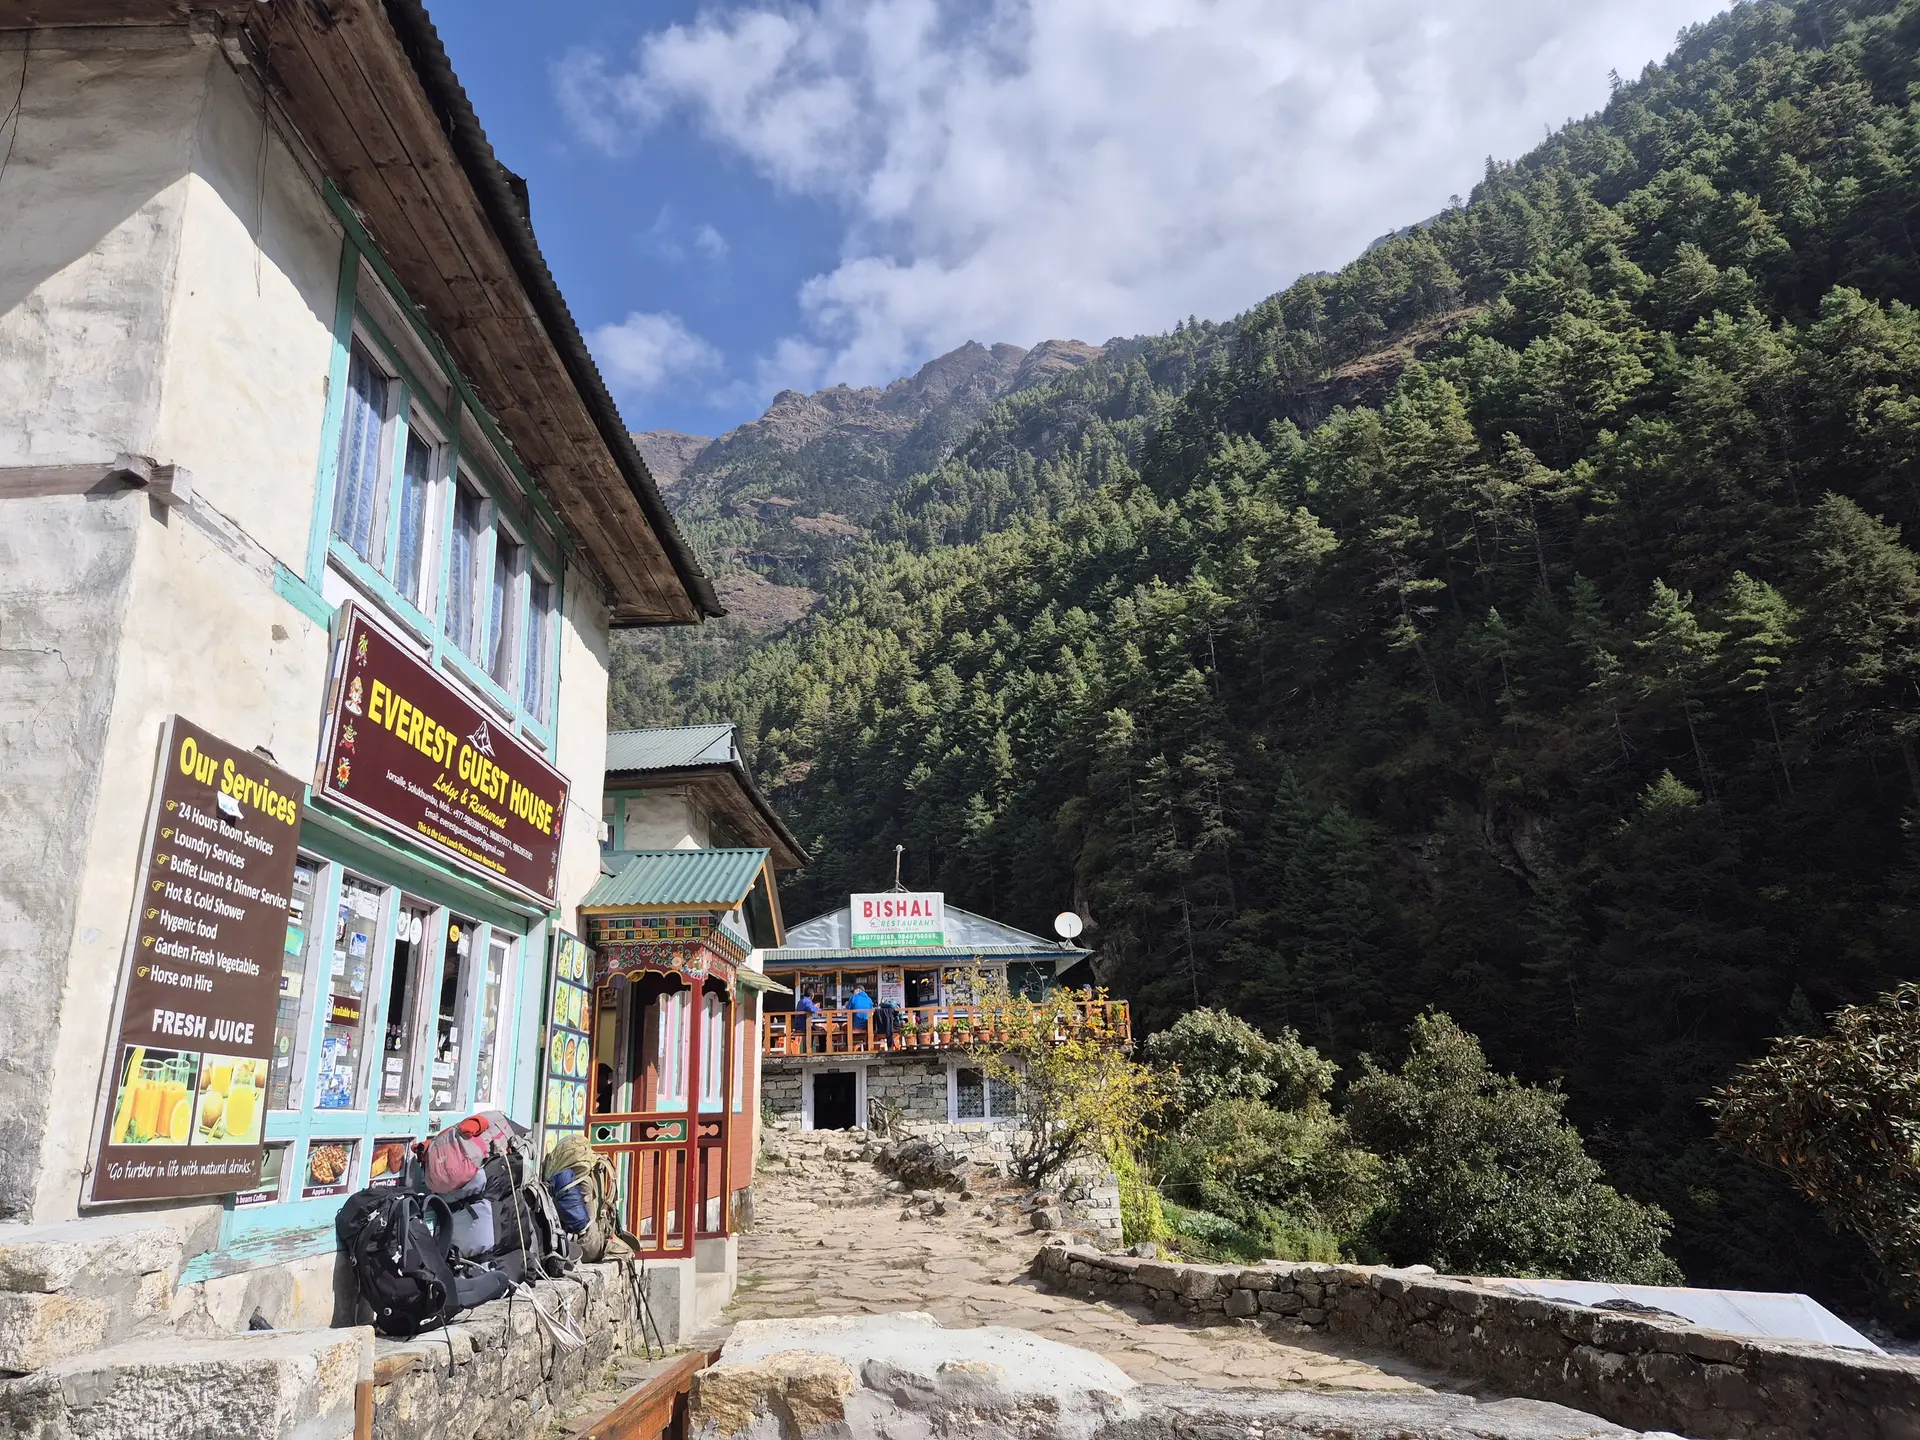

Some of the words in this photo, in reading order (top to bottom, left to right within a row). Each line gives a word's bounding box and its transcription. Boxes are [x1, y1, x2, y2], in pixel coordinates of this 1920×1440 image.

[368, 678, 457, 770] EVEREST
[458, 744, 510, 804] GUEST
[510, 782, 553, 836] HOUSE
[180, 736, 219, 786] Our
[220, 758, 297, 826] Services
[386, 769, 407, 790] Jorsalle,
[407, 782, 438, 808] Solukhumbu,
[425, 807, 440, 823] Email:
[432, 773, 460, 803] Lodge
[460, 788, 468, 804] &
[468, 793, 507, 829] Restaurant
[174, 828, 211, 859] Loundry
[212, 843, 245, 869] Services
[178, 803, 191, 820] 24
[191, 808, 218, 836] Hours
[219, 819, 243, 843] Room
[244, 830, 274, 856] Services
[417, 821, 427, 833] This
[446, 836, 458, 849] Lunch
[458, 843, 468, 855] Place
[170, 854, 198, 879] Buffet
[199, 865, 224, 890] Lunch
[225, 874, 232, 891] &
[233, 877, 260, 902] Dinner
[260, 888, 287, 910] Service
[165, 882, 183, 903] Hot
[184, 888, 192, 904] &
[193, 892, 213, 911] Cold
[214, 899, 245, 921] Shower
[863, 900, 933, 918] BISHAL
[160, 909, 195, 935] Hygenic
[196, 918, 218, 940] food
[154, 937, 189, 960] Garden
[191, 945, 215, 967] Fresh
[216, 951, 260, 976] Vegetables
[150, 965, 178, 985] Horse
[180, 974, 193, 988] on
[194, 974, 213, 993] Hire
[152, 1008, 206, 1039] FRESH
[209, 1018, 255, 1045] JUICE
[107, 1162, 123, 1180] "Go
[124, 1160, 155, 1180] further
[157, 1161, 165, 1176] in
[167, 1160, 180, 1177] life
[181, 1160, 199, 1176] with
[200, 1160, 228, 1176] natural
[240, 1196, 253, 1204] beans
[253, 1193, 267, 1203] Coffee
[312, 1187, 326, 1197] Apple
[326, 1187, 334, 1195] Pie
